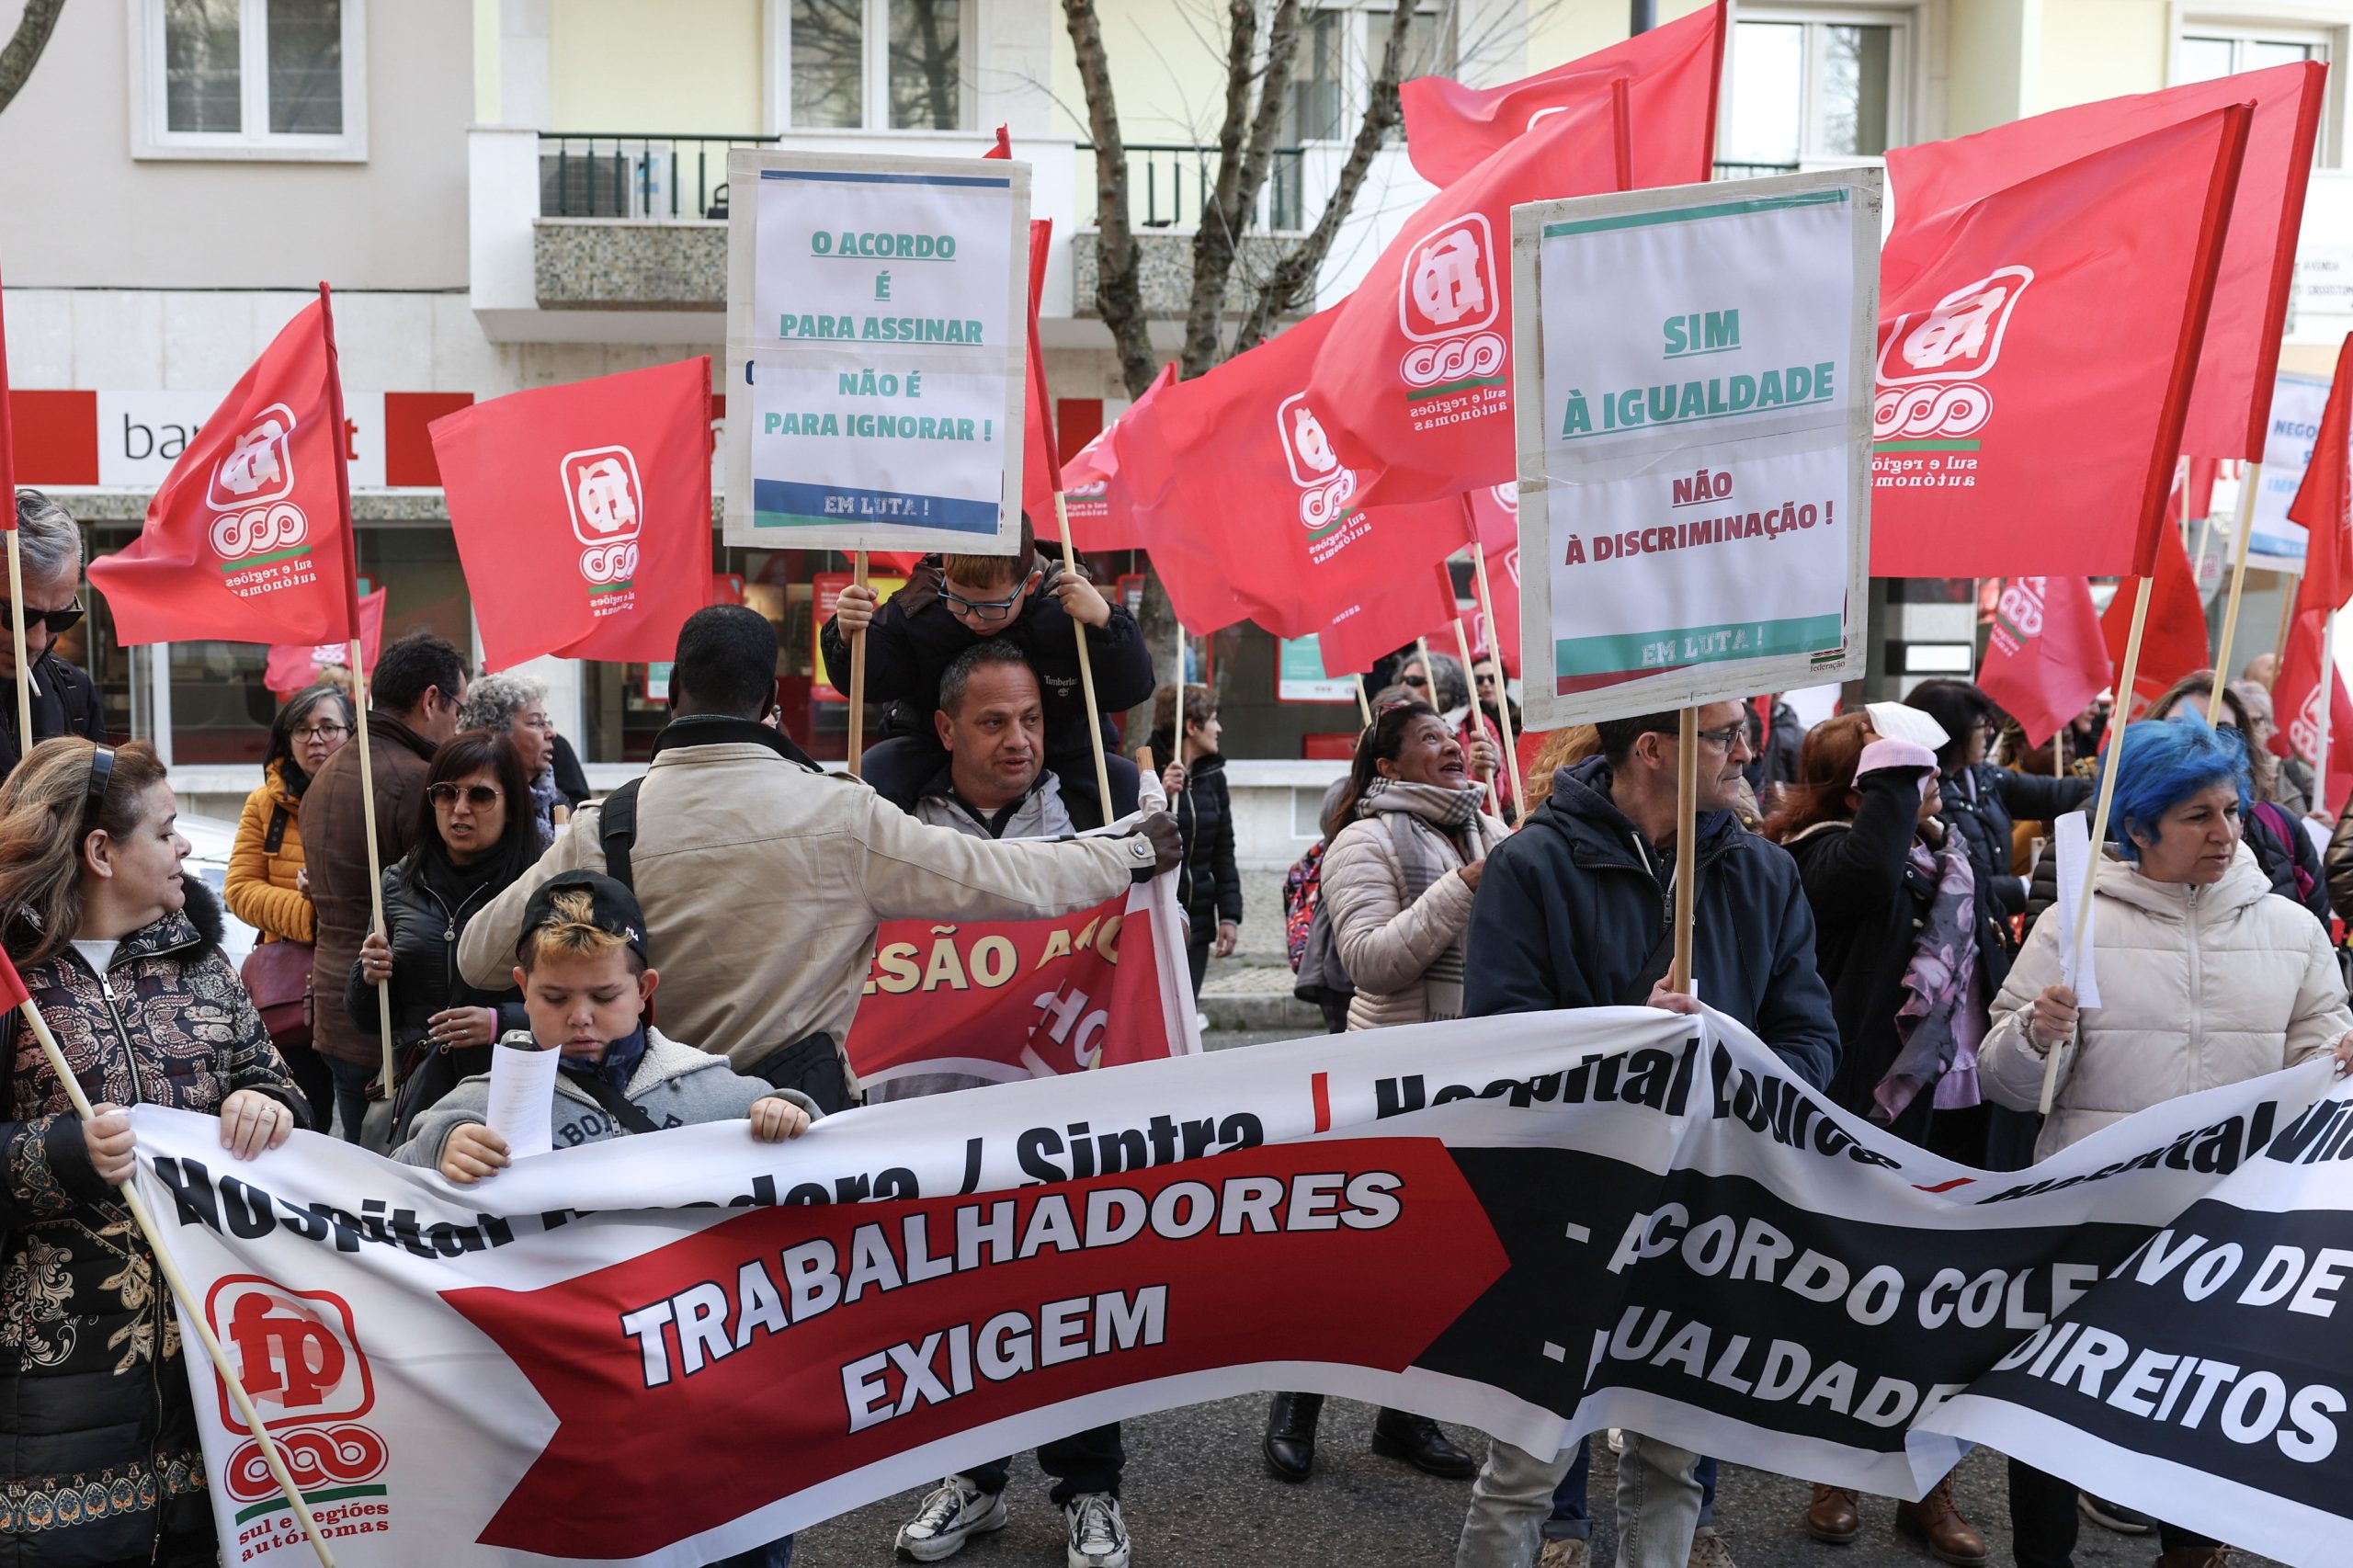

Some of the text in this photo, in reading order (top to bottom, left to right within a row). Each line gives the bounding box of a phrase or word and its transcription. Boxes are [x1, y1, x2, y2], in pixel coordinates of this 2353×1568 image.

[811, 230, 956, 258] O ACORDO
[875, 270, 892, 299] É
[779, 314, 983, 344] PARA ASSINAR
[1663, 309, 1741, 355] SIM
[838, 368, 922, 398] NÃO É
[1563, 361, 1835, 435] À IGUALDADE
[764, 412, 993, 442] PARA IGNORAR !
[824, 495, 855, 515] EM
[860, 497, 918, 517] LUTA
[1671, 469, 1733, 505] NÃO
[1564, 500, 1834, 566] À DISCRIMINAÇÃO !
[1640, 641, 1677, 666] EM
[1683, 630, 1752, 660] LUTA
[1810, 661, 1846, 673] federação
[1016, 1111, 1264, 1188] Sintra
[620, 1169, 1404, 1390] TRABALHADORES
[2235, 1244, 2353, 1319] DE
[840, 1283, 1169, 1437] EXIGEM
[1991, 1321, 2347, 1463] DIREITOS
[238, 1502, 390, 1546] sul e egiões
